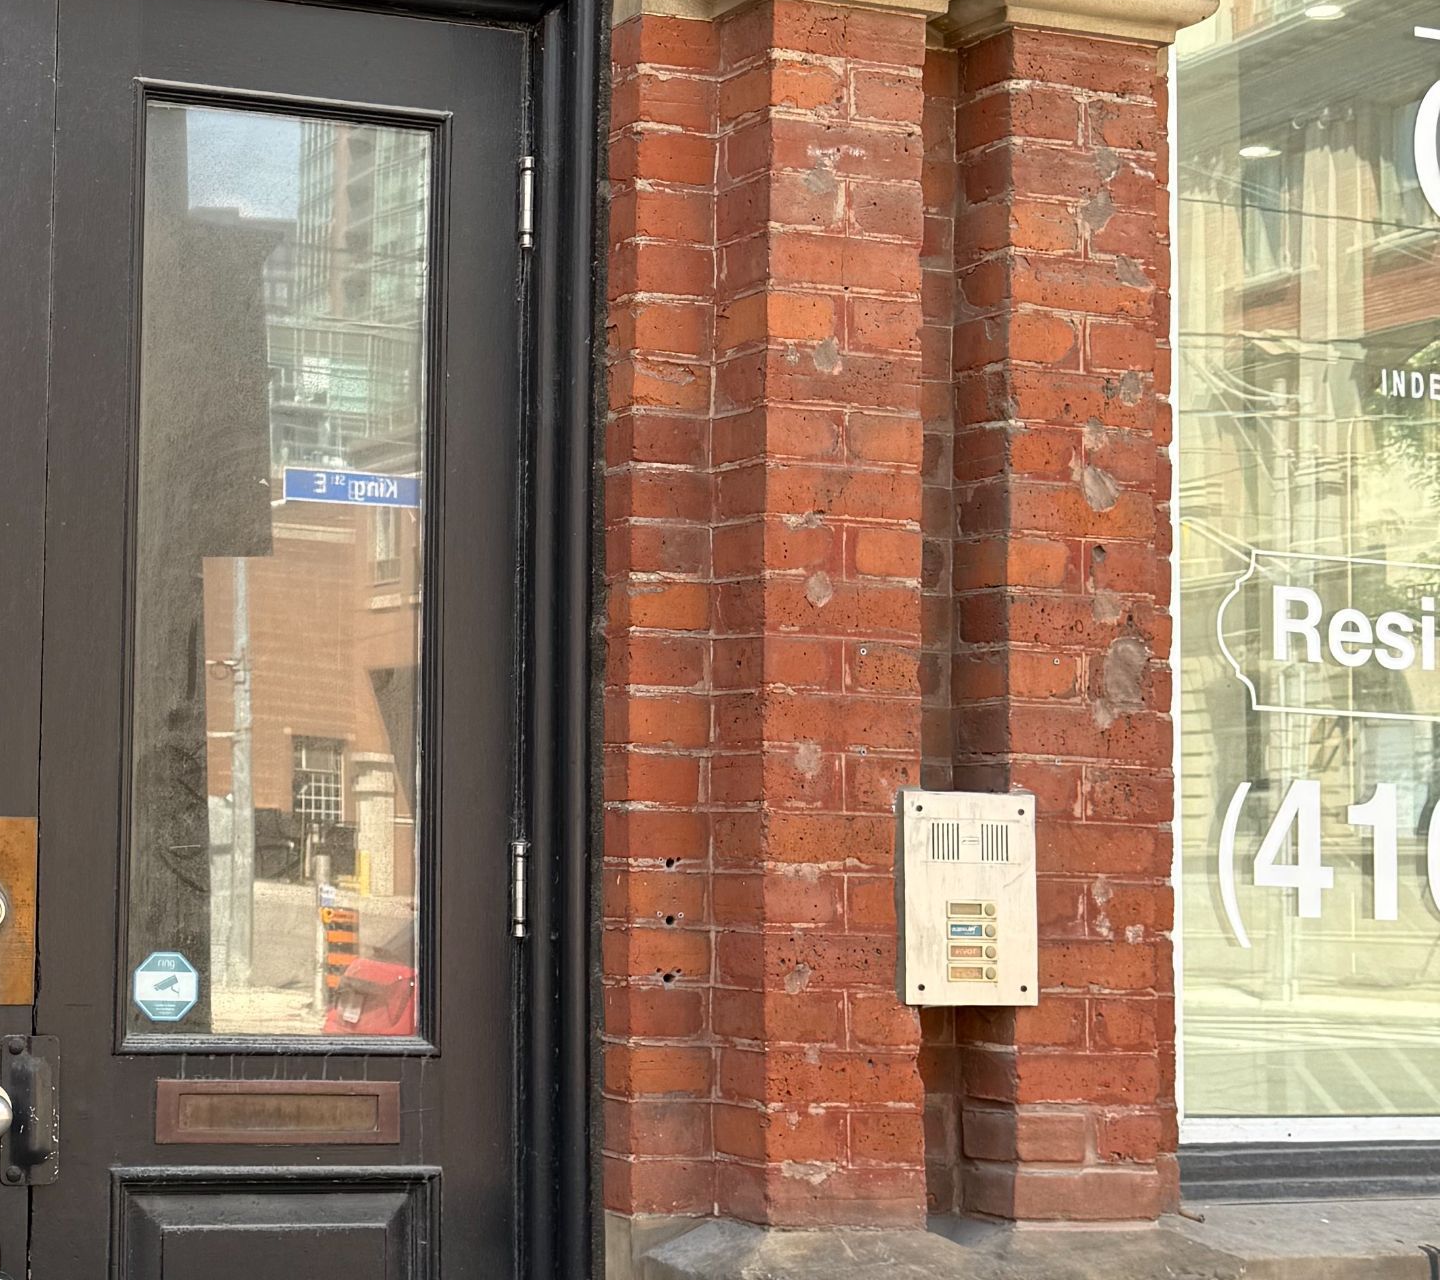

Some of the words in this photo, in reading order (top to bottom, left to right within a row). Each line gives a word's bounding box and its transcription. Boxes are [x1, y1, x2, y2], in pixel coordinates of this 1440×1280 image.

[1381, 368, 1440, 401] INDE
[1271, 584, 1435, 671] Resi
[1217, 779, 1440, 948] (41
[157, 959, 176, 970] ring
